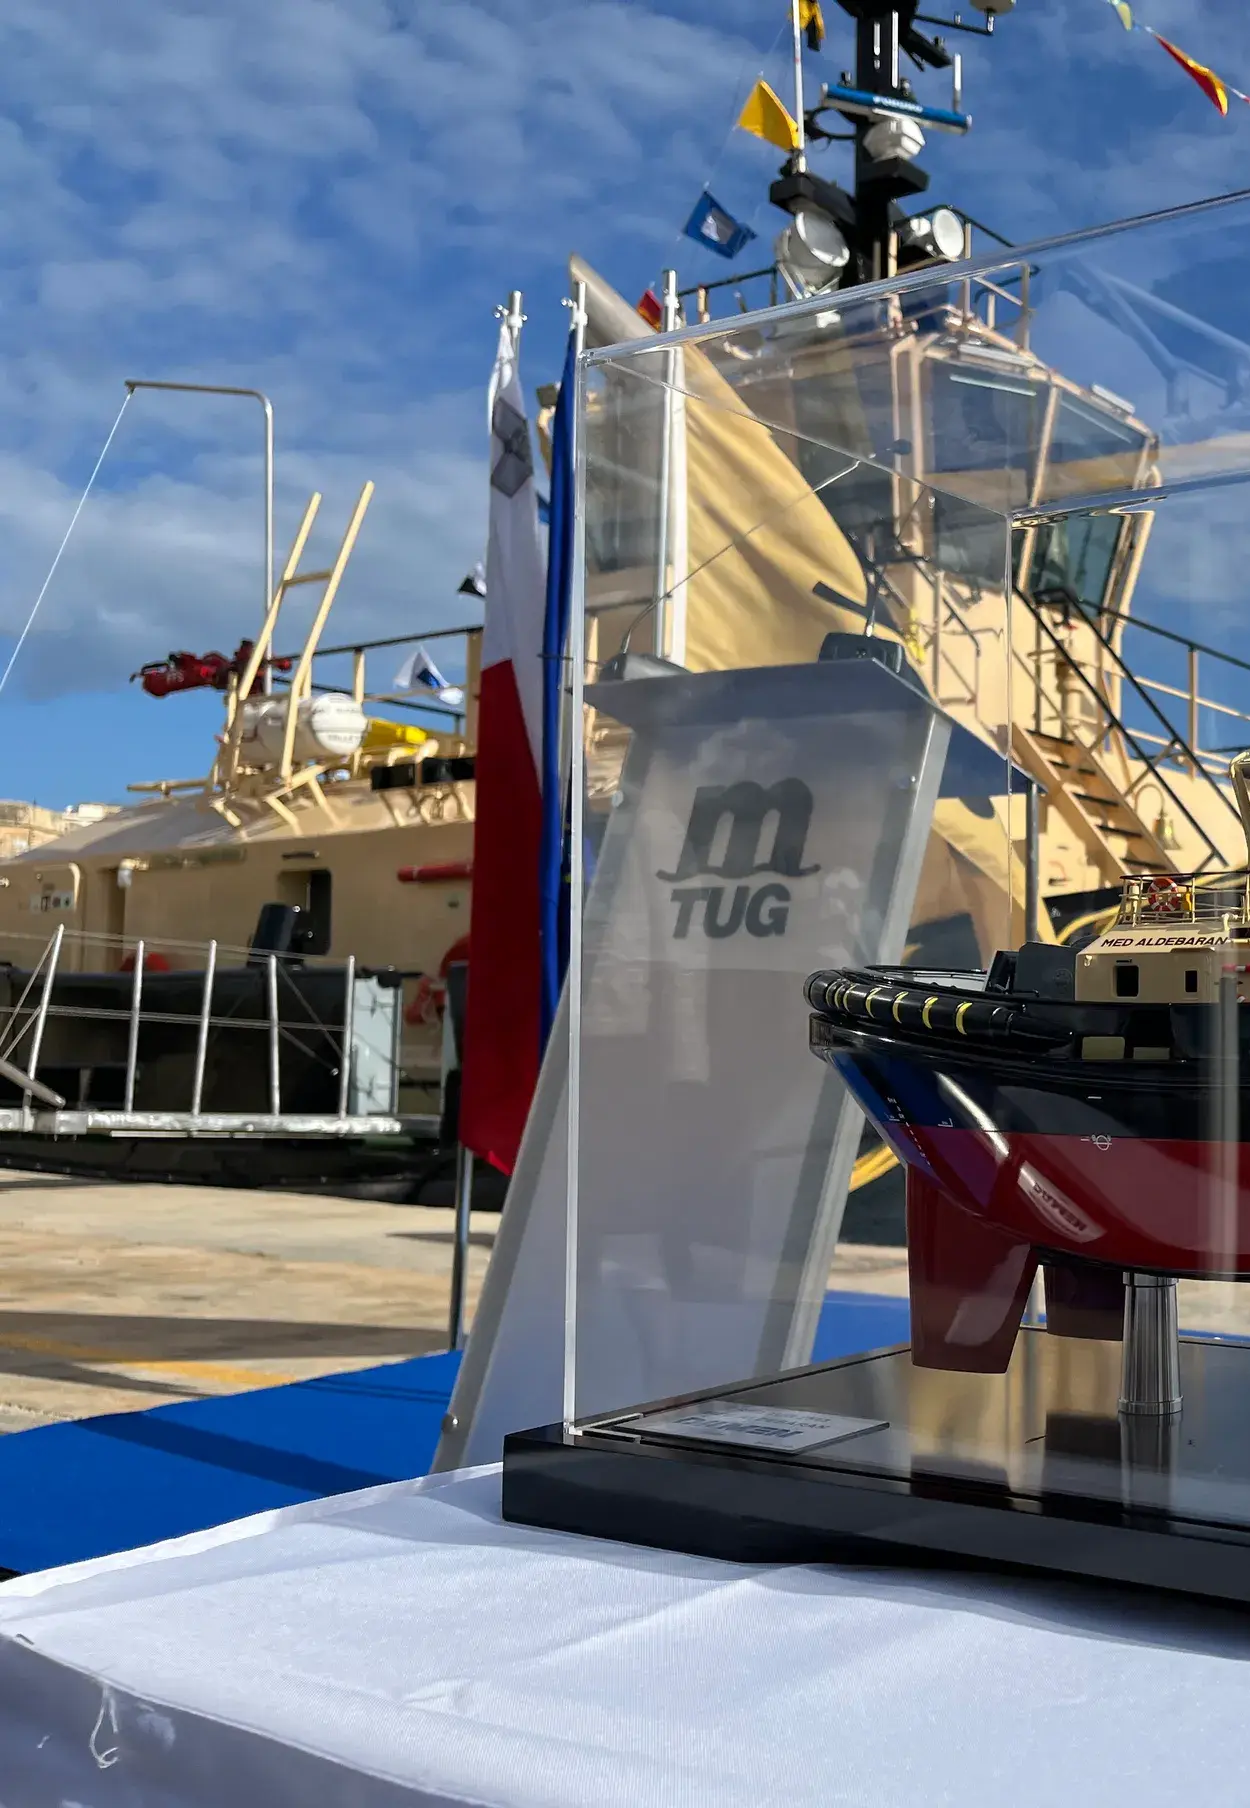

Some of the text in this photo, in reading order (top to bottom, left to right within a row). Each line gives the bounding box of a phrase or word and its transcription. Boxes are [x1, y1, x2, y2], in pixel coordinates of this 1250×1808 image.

[670, 883, 791, 939] TUG
[1100, 936, 1229, 948] MED ALDEBARAN
